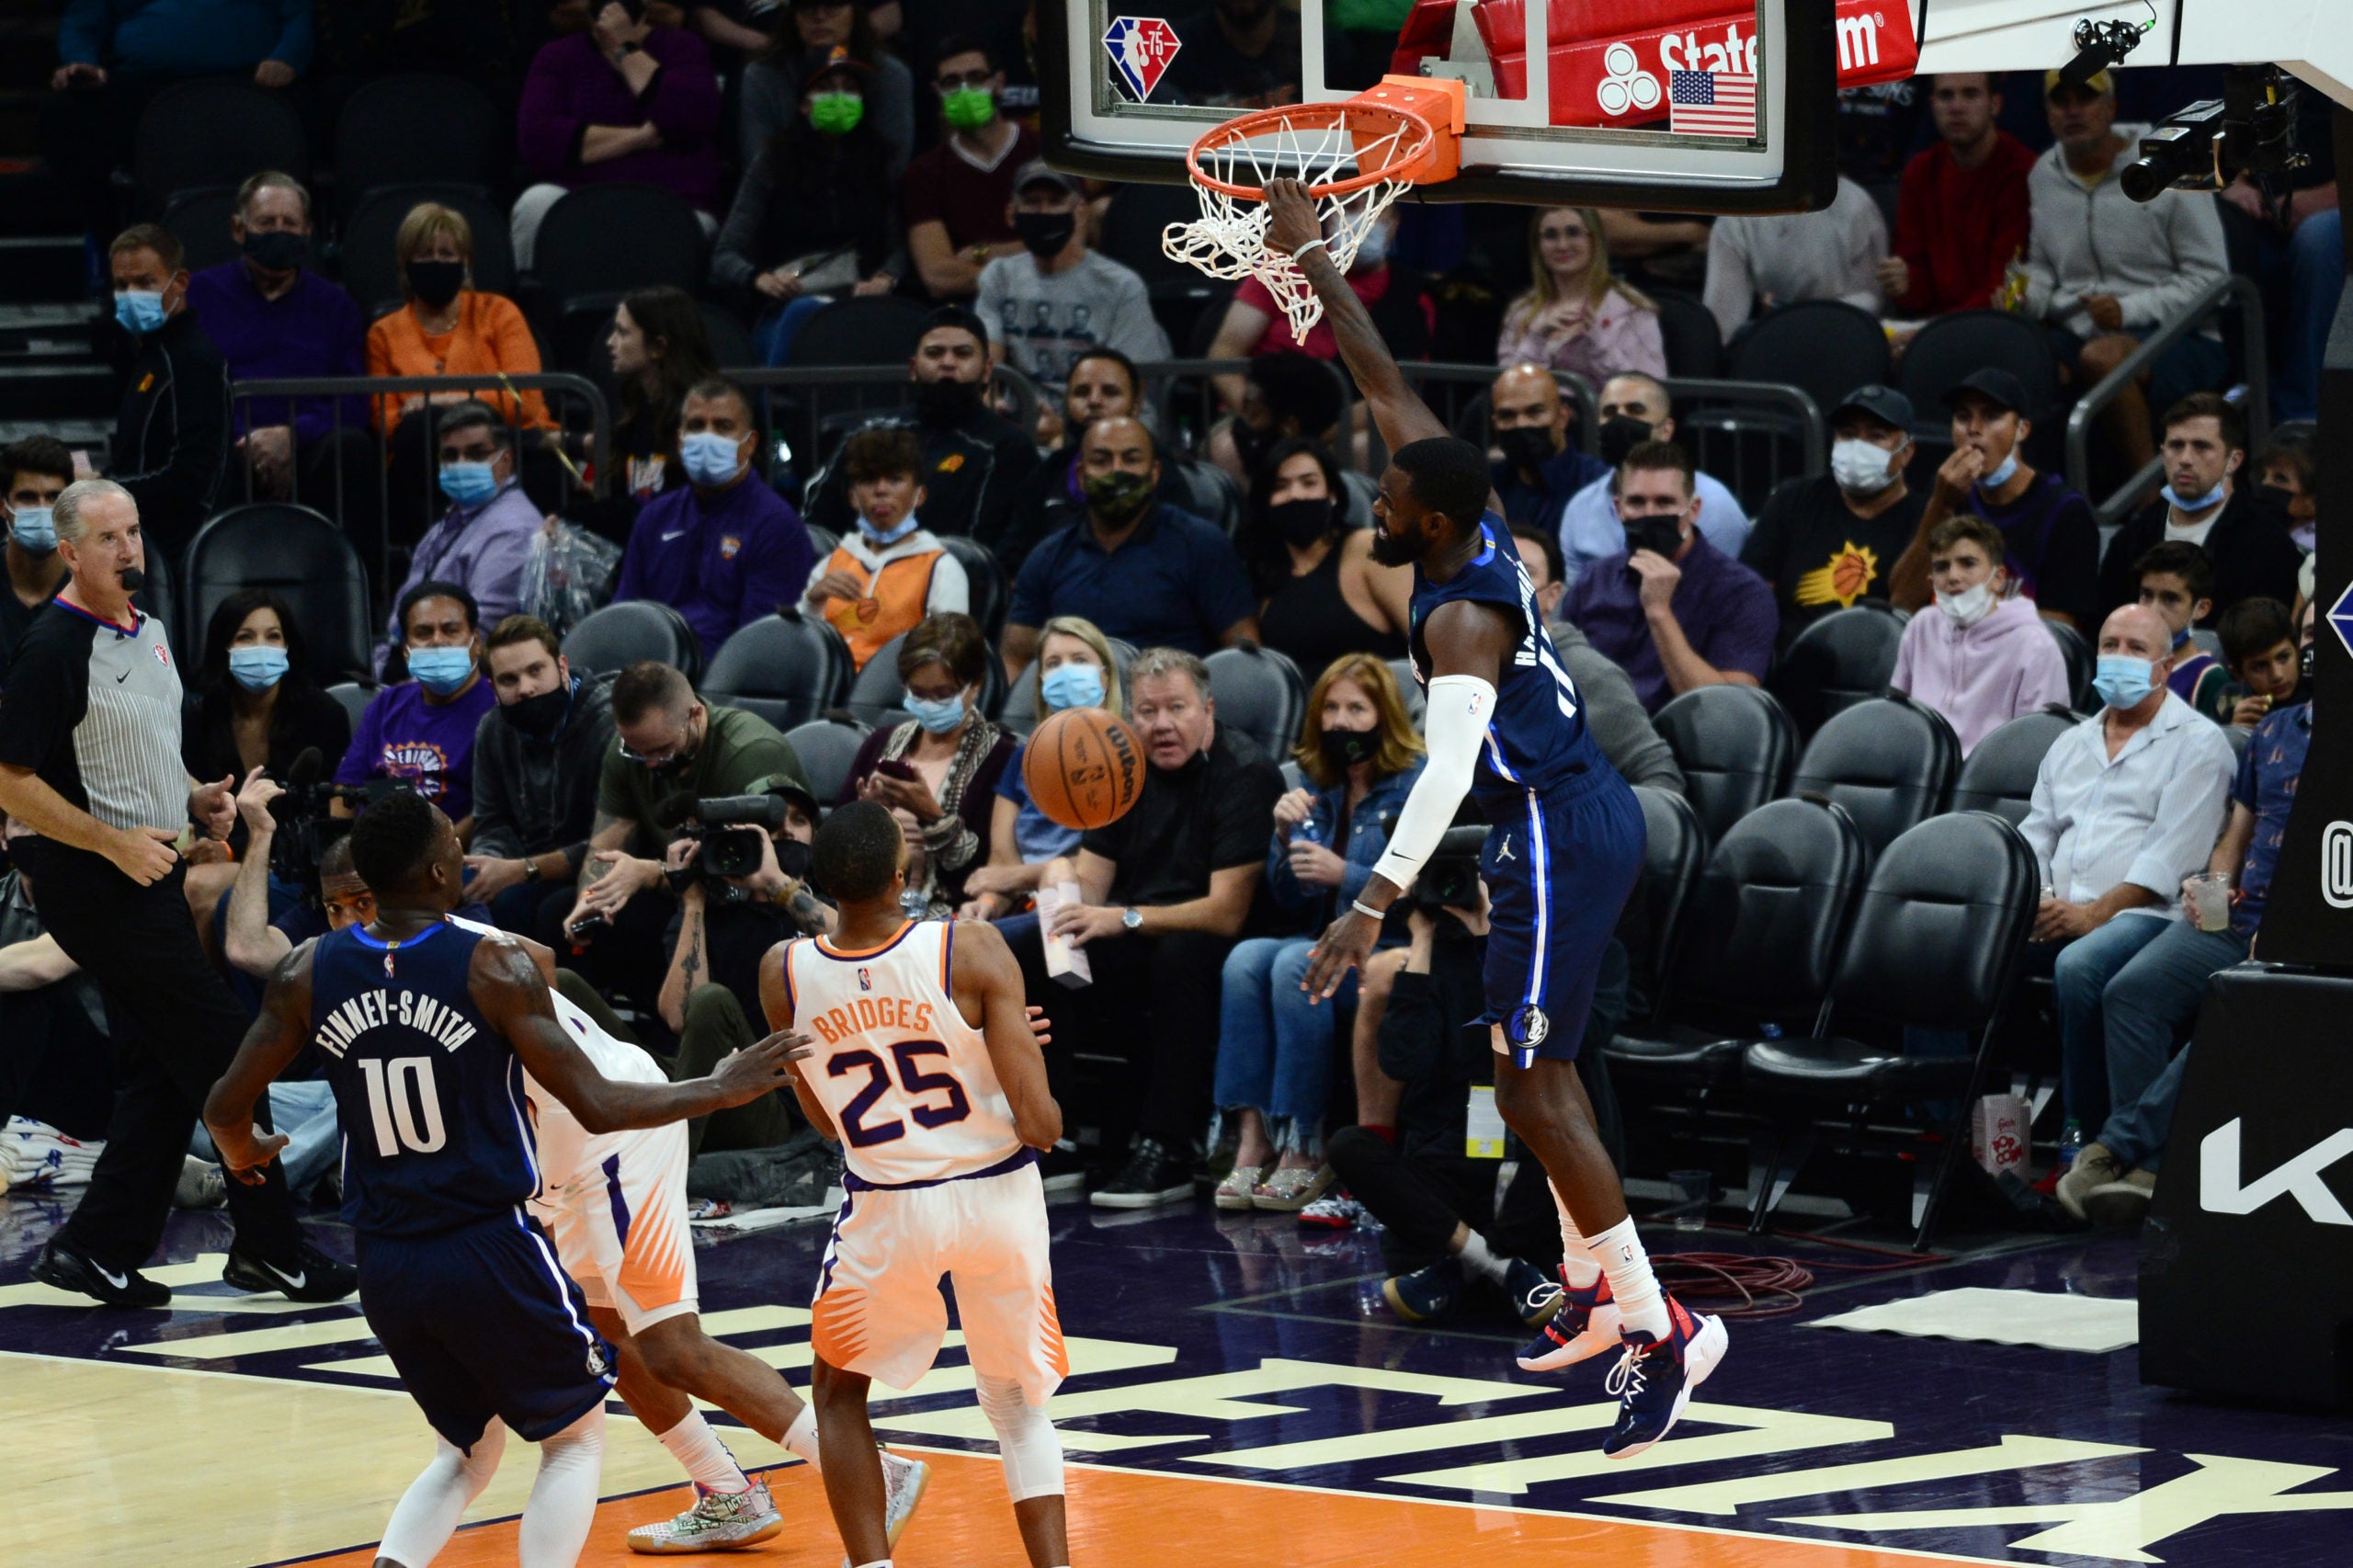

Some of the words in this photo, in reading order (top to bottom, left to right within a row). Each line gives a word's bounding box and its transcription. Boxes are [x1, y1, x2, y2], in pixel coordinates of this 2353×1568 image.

[1148, 30, 1164, 56] 75
[315, 989, 477, 1059] FINNEY-SMITH
[812, 996, 932, 1045] BRIDGES
[358, 1056, 447, 1157] 10
[825, 1040, 972, 1149] 25
